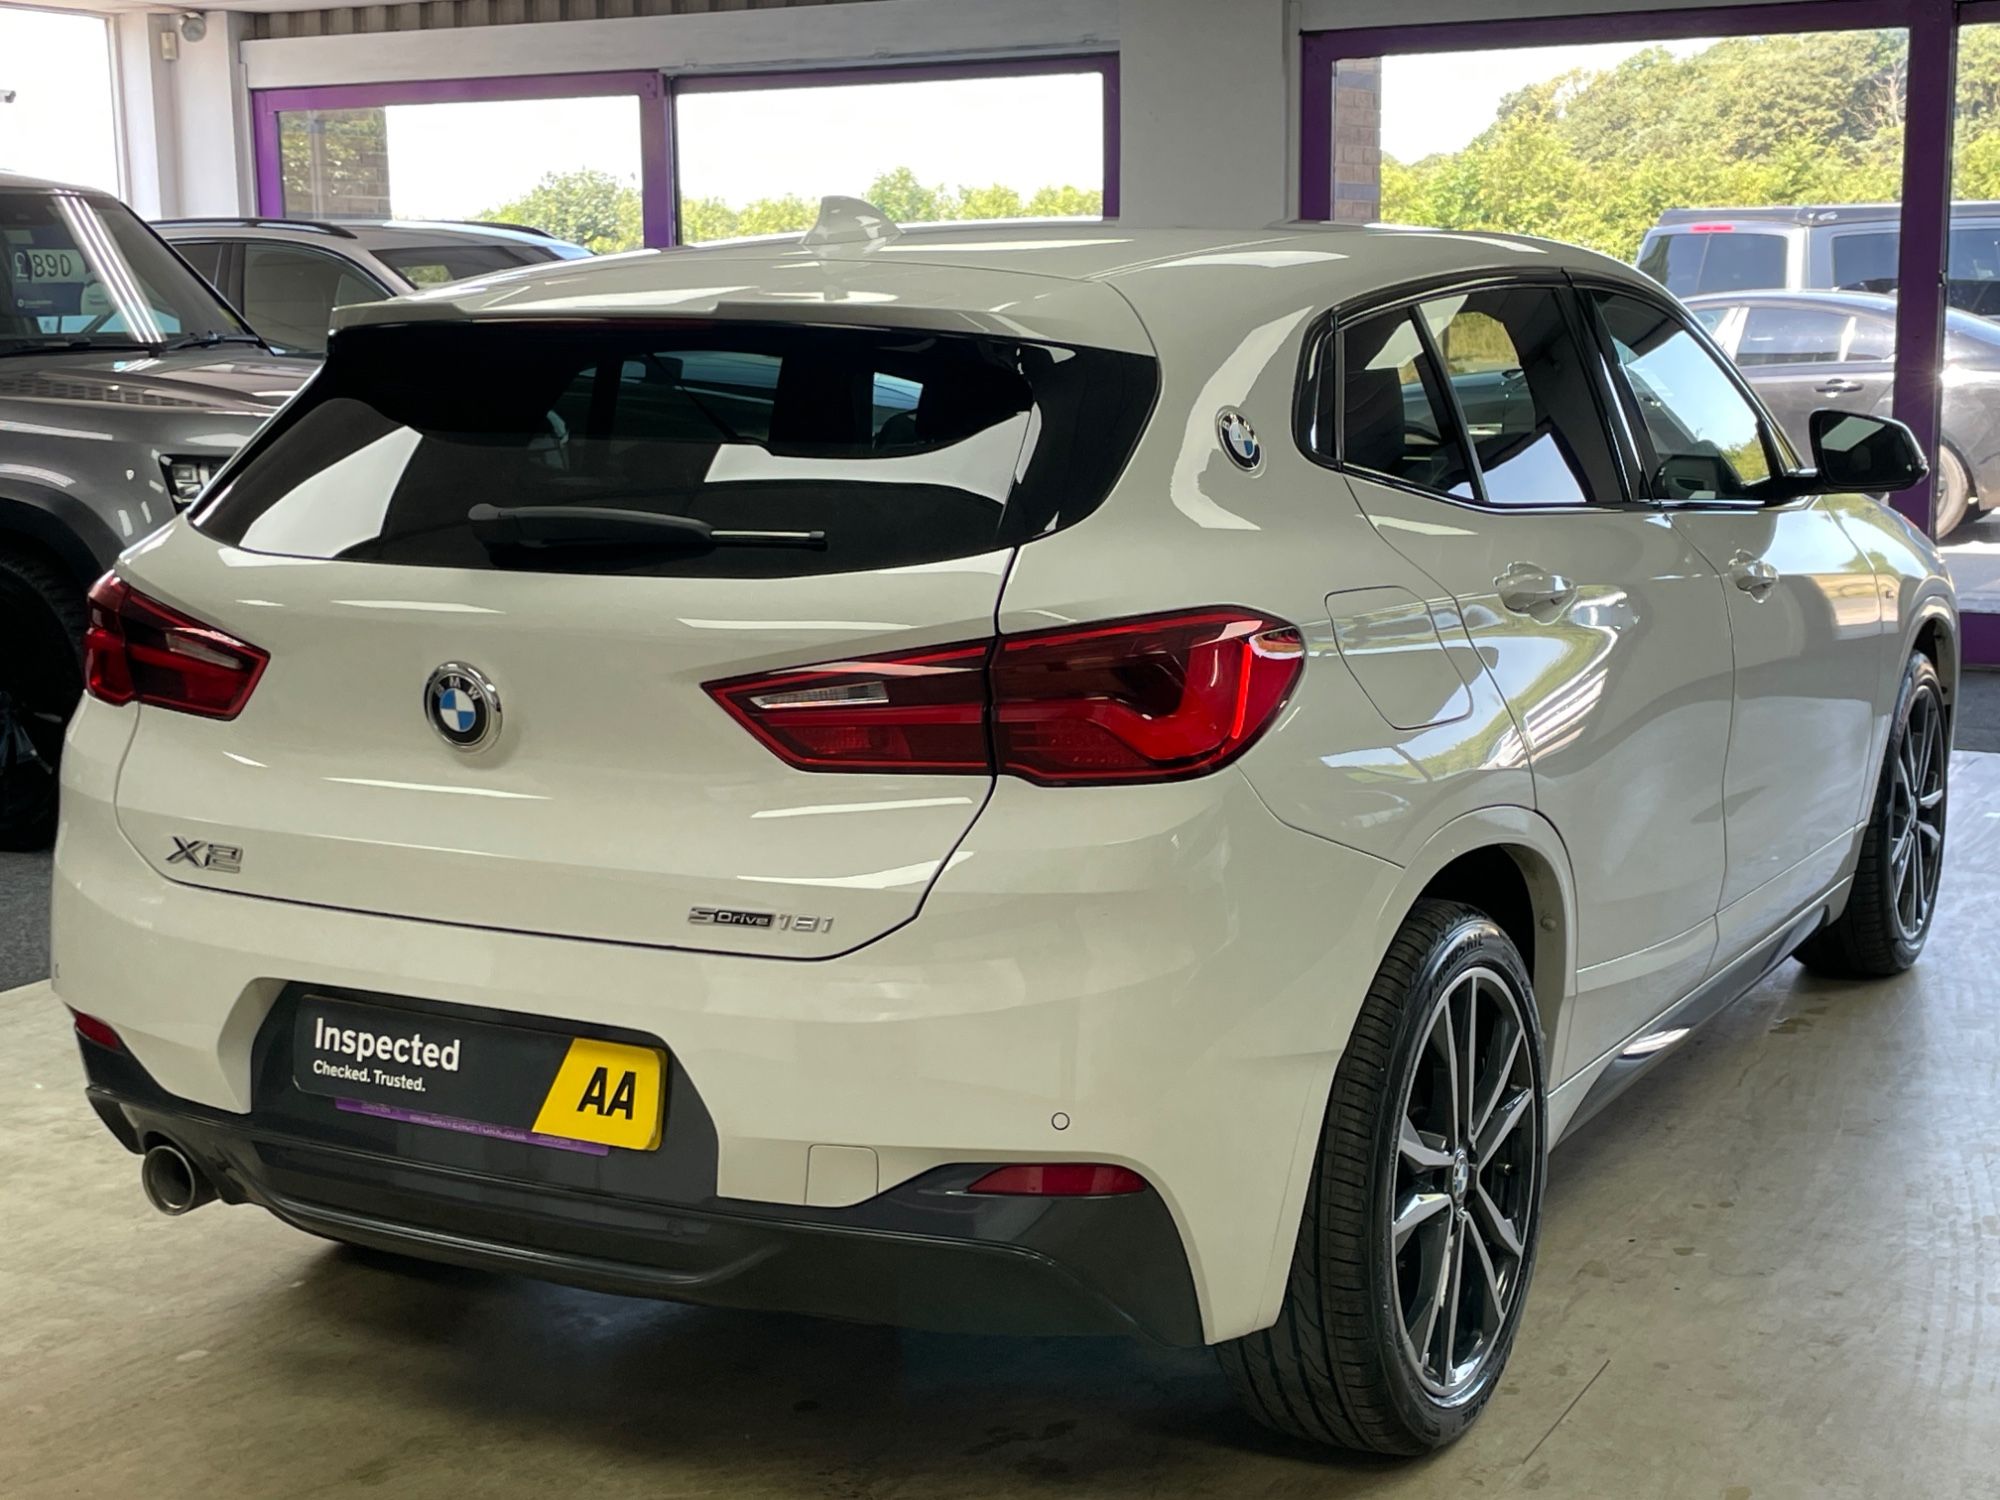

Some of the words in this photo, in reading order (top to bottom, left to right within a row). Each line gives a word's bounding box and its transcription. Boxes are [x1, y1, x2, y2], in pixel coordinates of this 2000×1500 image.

[165, 836, 243, 874] X2
[315, 1017, 461, 1072] Inspected
[313, 1059, 371, 1083] Checked.
[373, 1069, 426, 1092] Trusted.
[576, 1066, 636, 1120] AA
